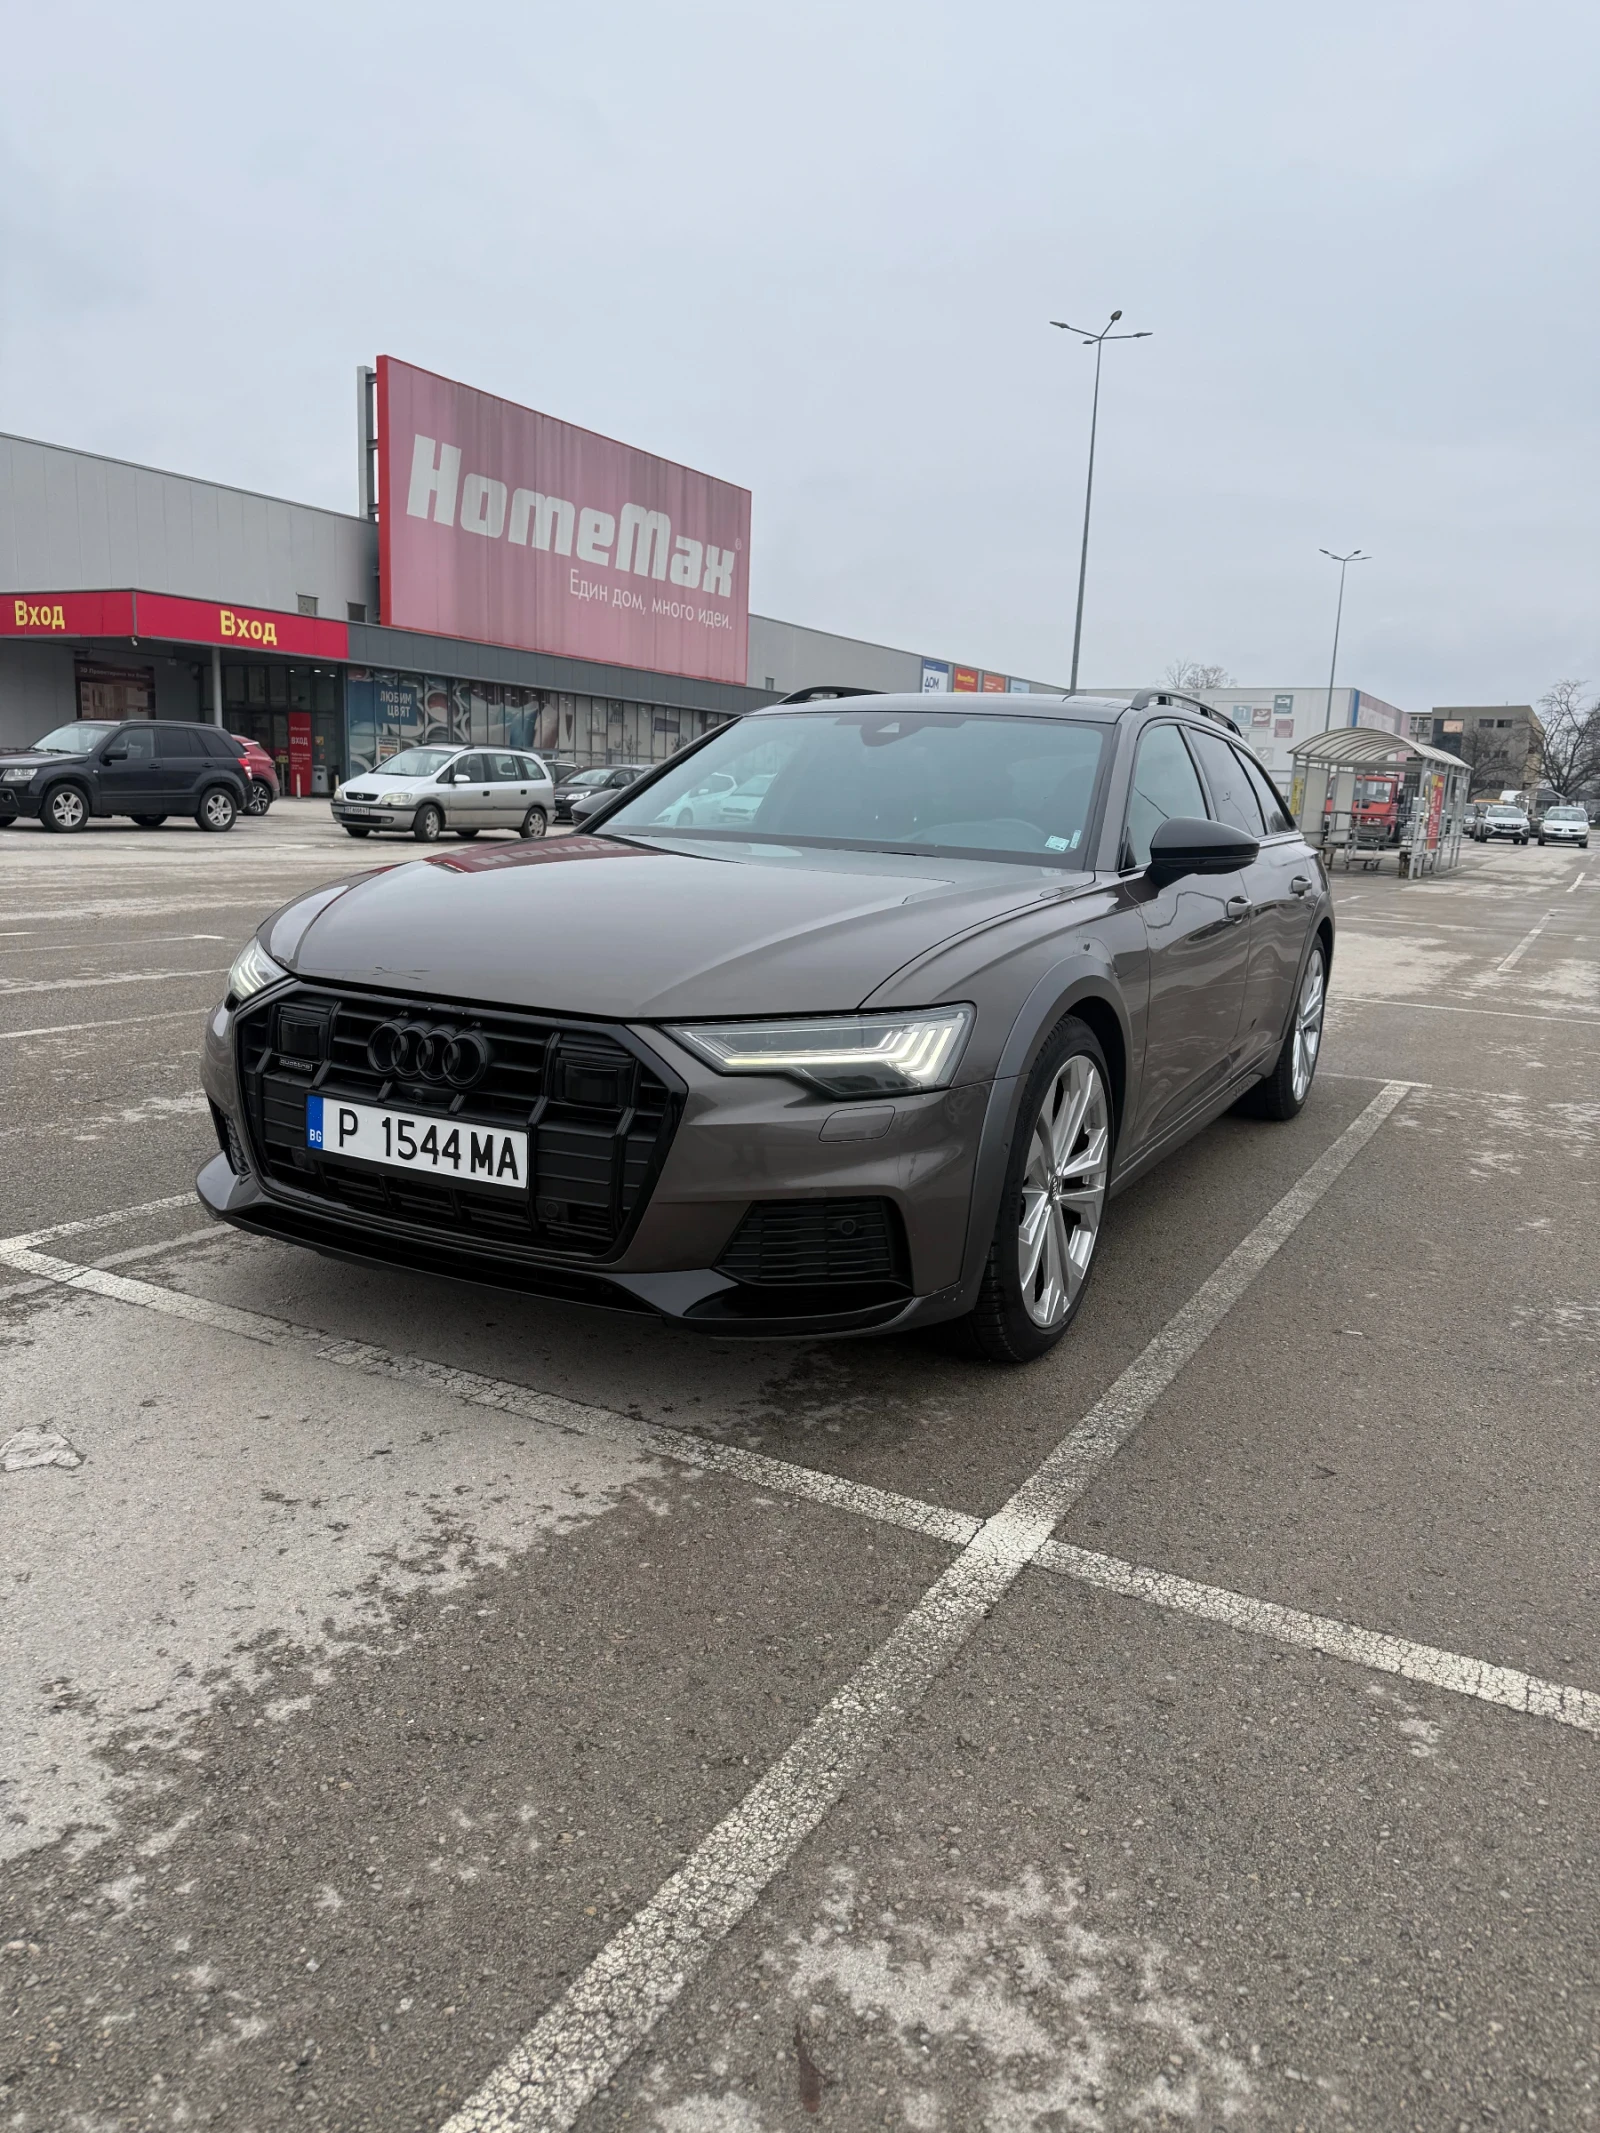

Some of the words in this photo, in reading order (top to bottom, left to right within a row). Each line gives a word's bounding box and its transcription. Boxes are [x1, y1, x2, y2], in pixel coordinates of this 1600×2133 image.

[406, 433, 736, 598] HomeMax
[569, 568, 608, 602] Един
[612, 588, 647, 615] дом,
[651, 599, 694, 621] много
[698, 608, 732, 630] идеи.
[14, 600, 65, 629] Вход
[219, 610, 277, 645] Вход
[380, 690, 412, 705] ЛЮБИМ
[387, 704, 410, 718] ЦВЯТ
[291, 736, 308, 747] ВХОД
[309, 1129, 322, 1143] BG
[339, 1107, 358, 1147] P
[382, 1116, 461, 1170] 1544
[470, 1131, 519, 1180] MA
